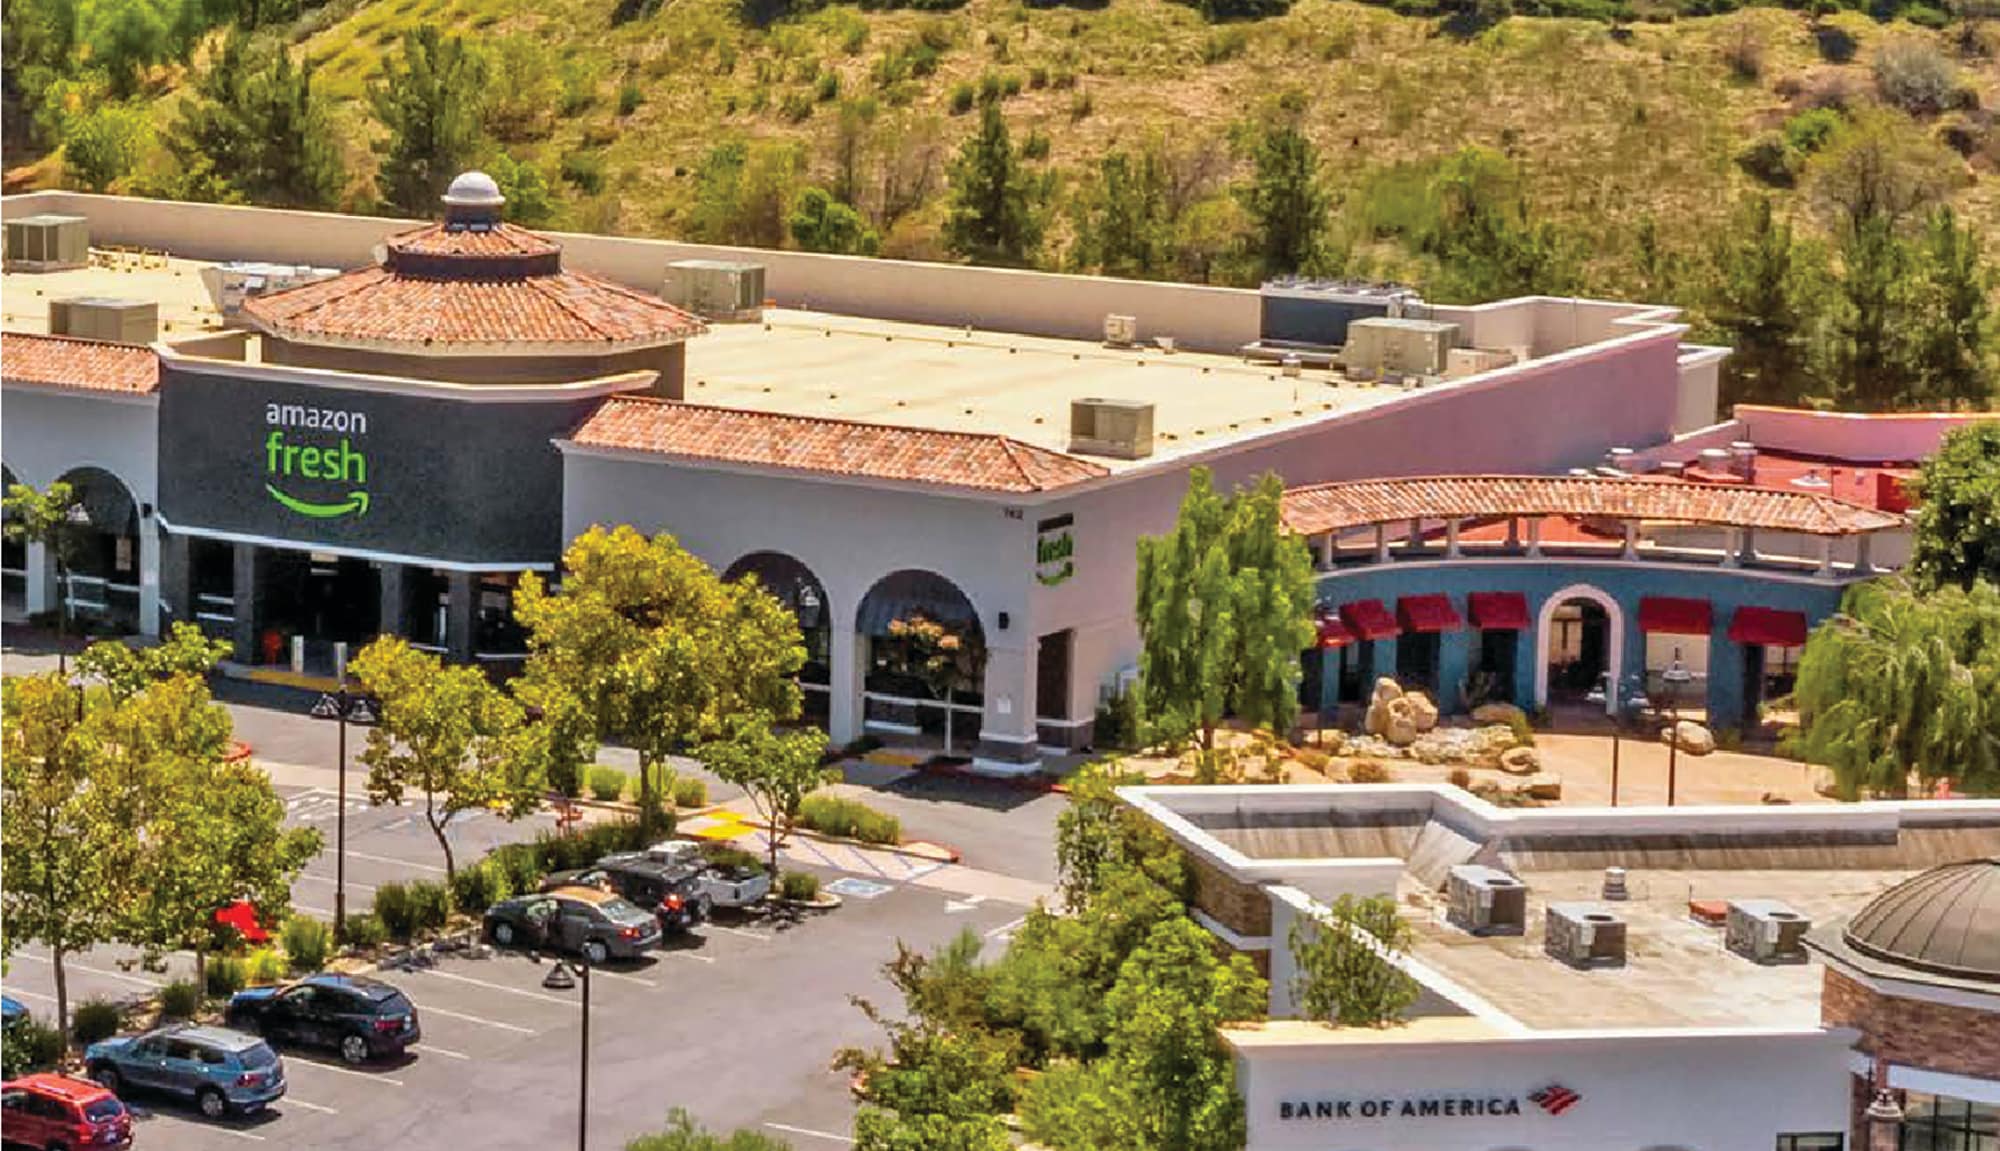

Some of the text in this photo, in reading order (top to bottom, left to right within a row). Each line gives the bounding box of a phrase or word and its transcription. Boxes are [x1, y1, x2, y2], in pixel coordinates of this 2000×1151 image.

[265, 402, 367, 434] amazon
[265, 431, 367, 484] fresh
[1280, 1097, 1520, 1119] BANK OF AMERICA
